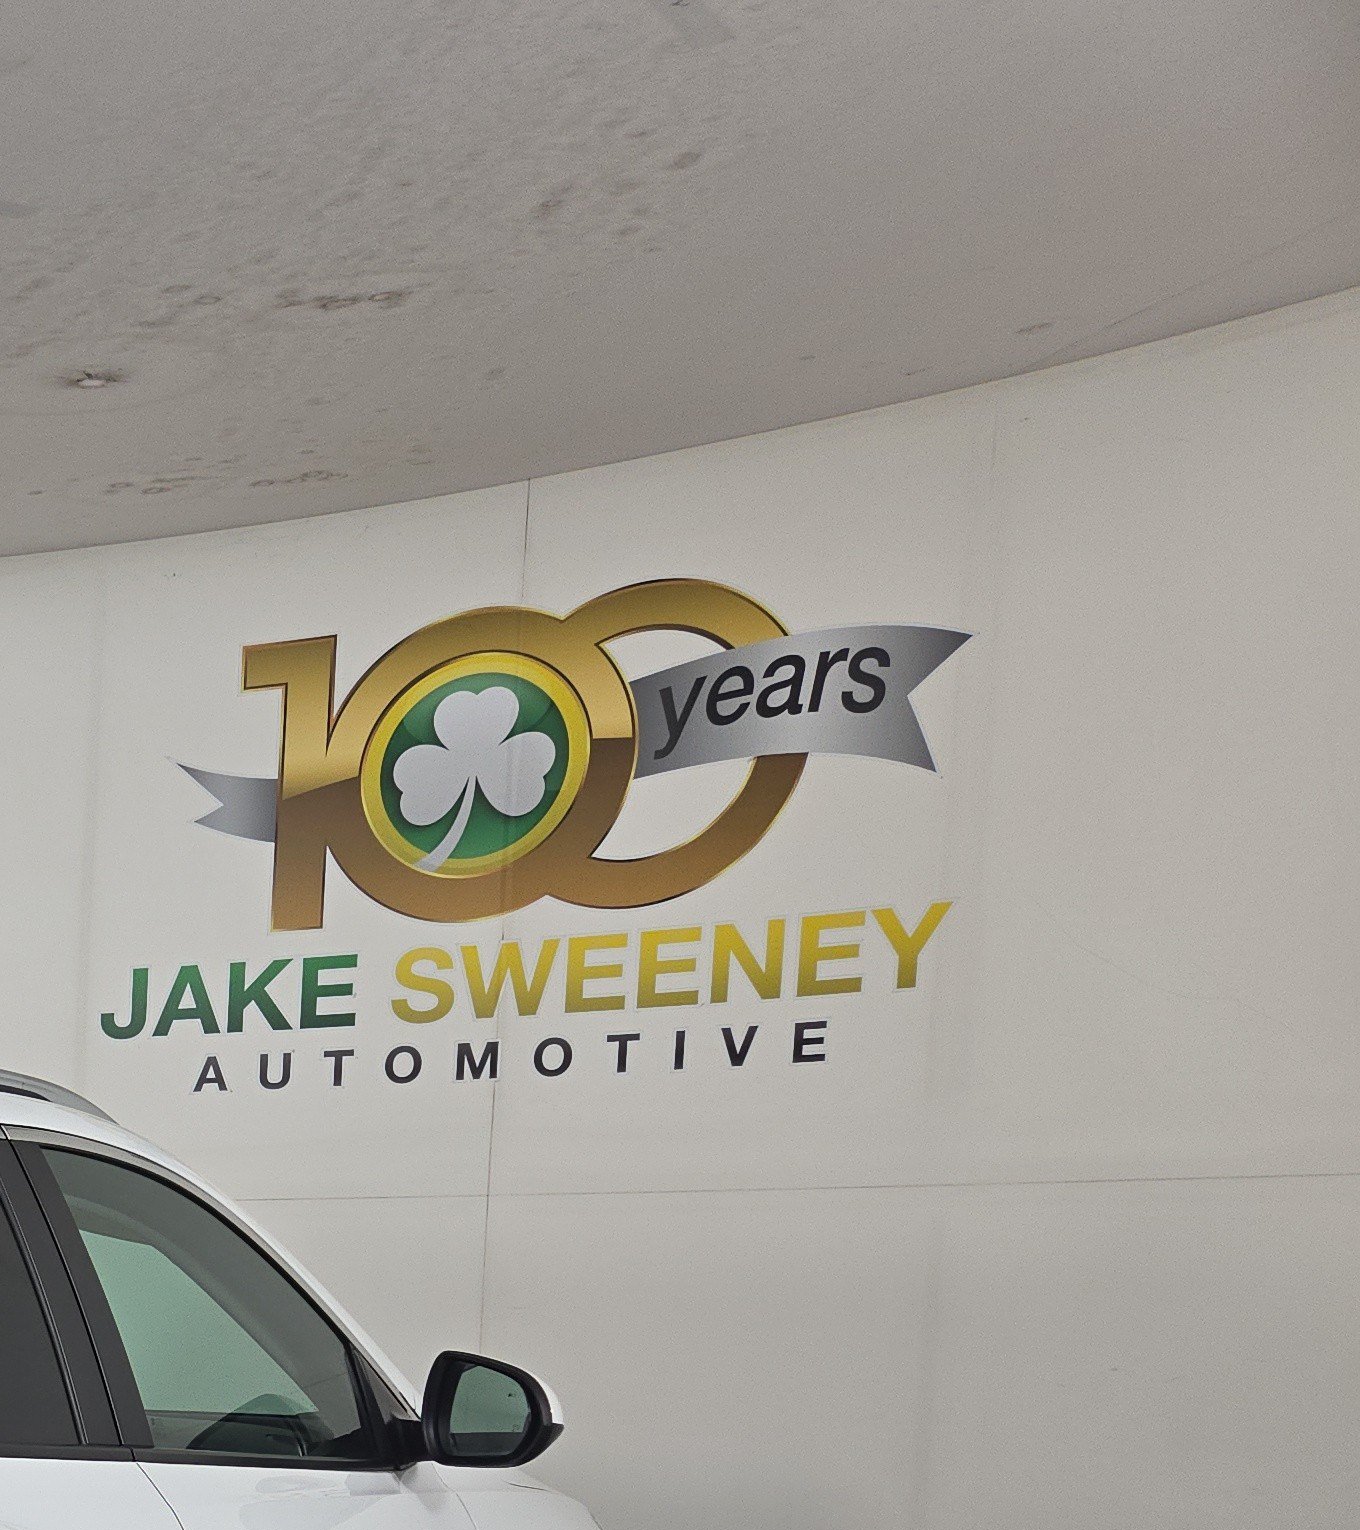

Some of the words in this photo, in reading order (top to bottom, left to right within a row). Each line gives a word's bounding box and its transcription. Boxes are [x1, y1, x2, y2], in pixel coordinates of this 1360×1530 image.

[241, 577, 811, 933] 100
[653, 645, 892, 761] years
[99, 952, 359, 1040] JAKE
[391, 901, 954, 1025] SWEENEY
[192, 1019, 829, 1094] AUTOMOTIVE
